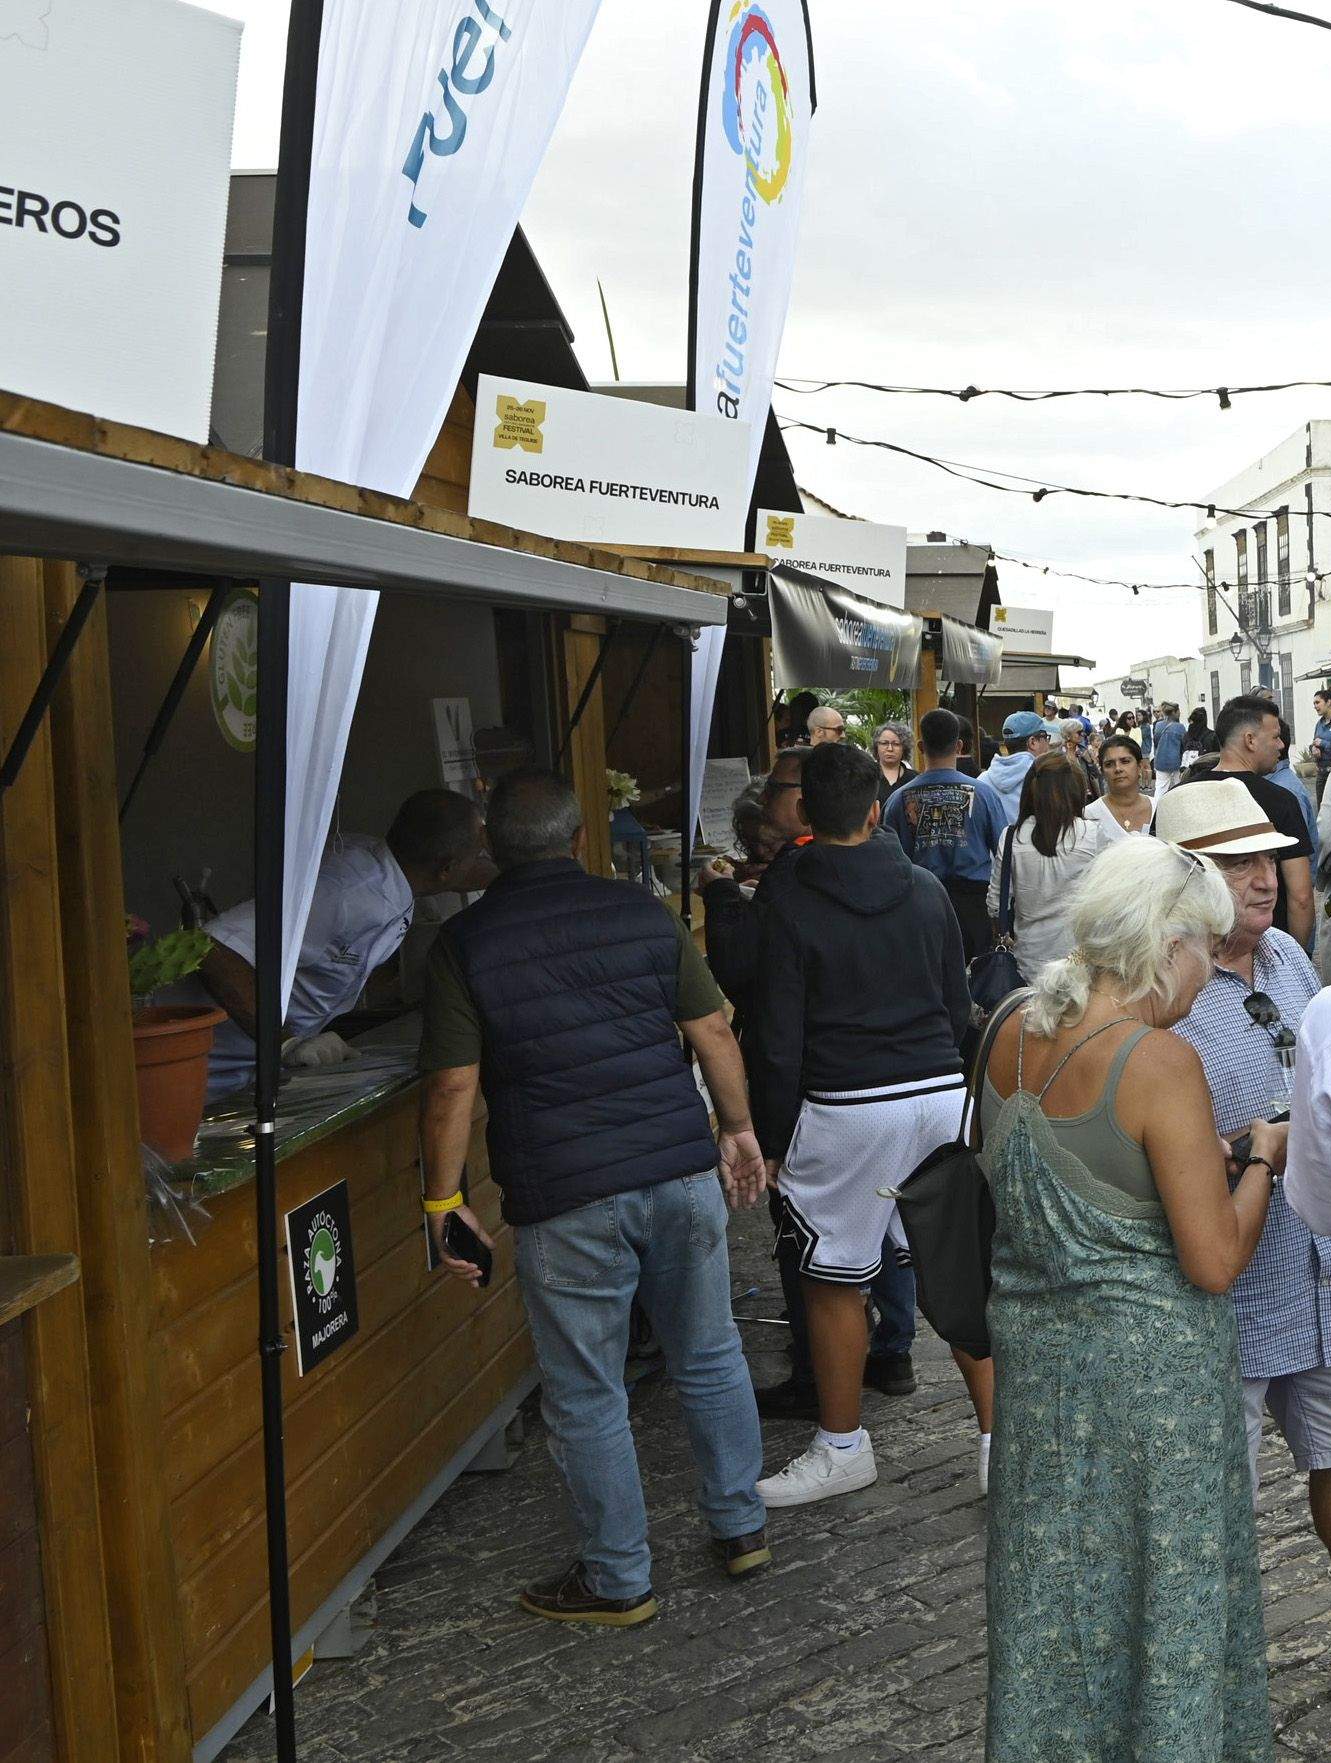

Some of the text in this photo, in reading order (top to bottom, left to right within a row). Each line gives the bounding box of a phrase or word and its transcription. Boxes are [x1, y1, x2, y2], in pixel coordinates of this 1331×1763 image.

[503, 424, 535, 435] FESTIVAL
[504, 413, 536, 424] saborea
[505, 469, 720, 510] SABOREA FUERTEVENTURA
[818, 563, 891, 578] FUERTEVENTURA
[303, 1209, 342, 1294] RAZA AUTÓCTONA
[318, 1289, 338, 1314] 100%
[311, 1310, 349, 1349] MAJORERA
